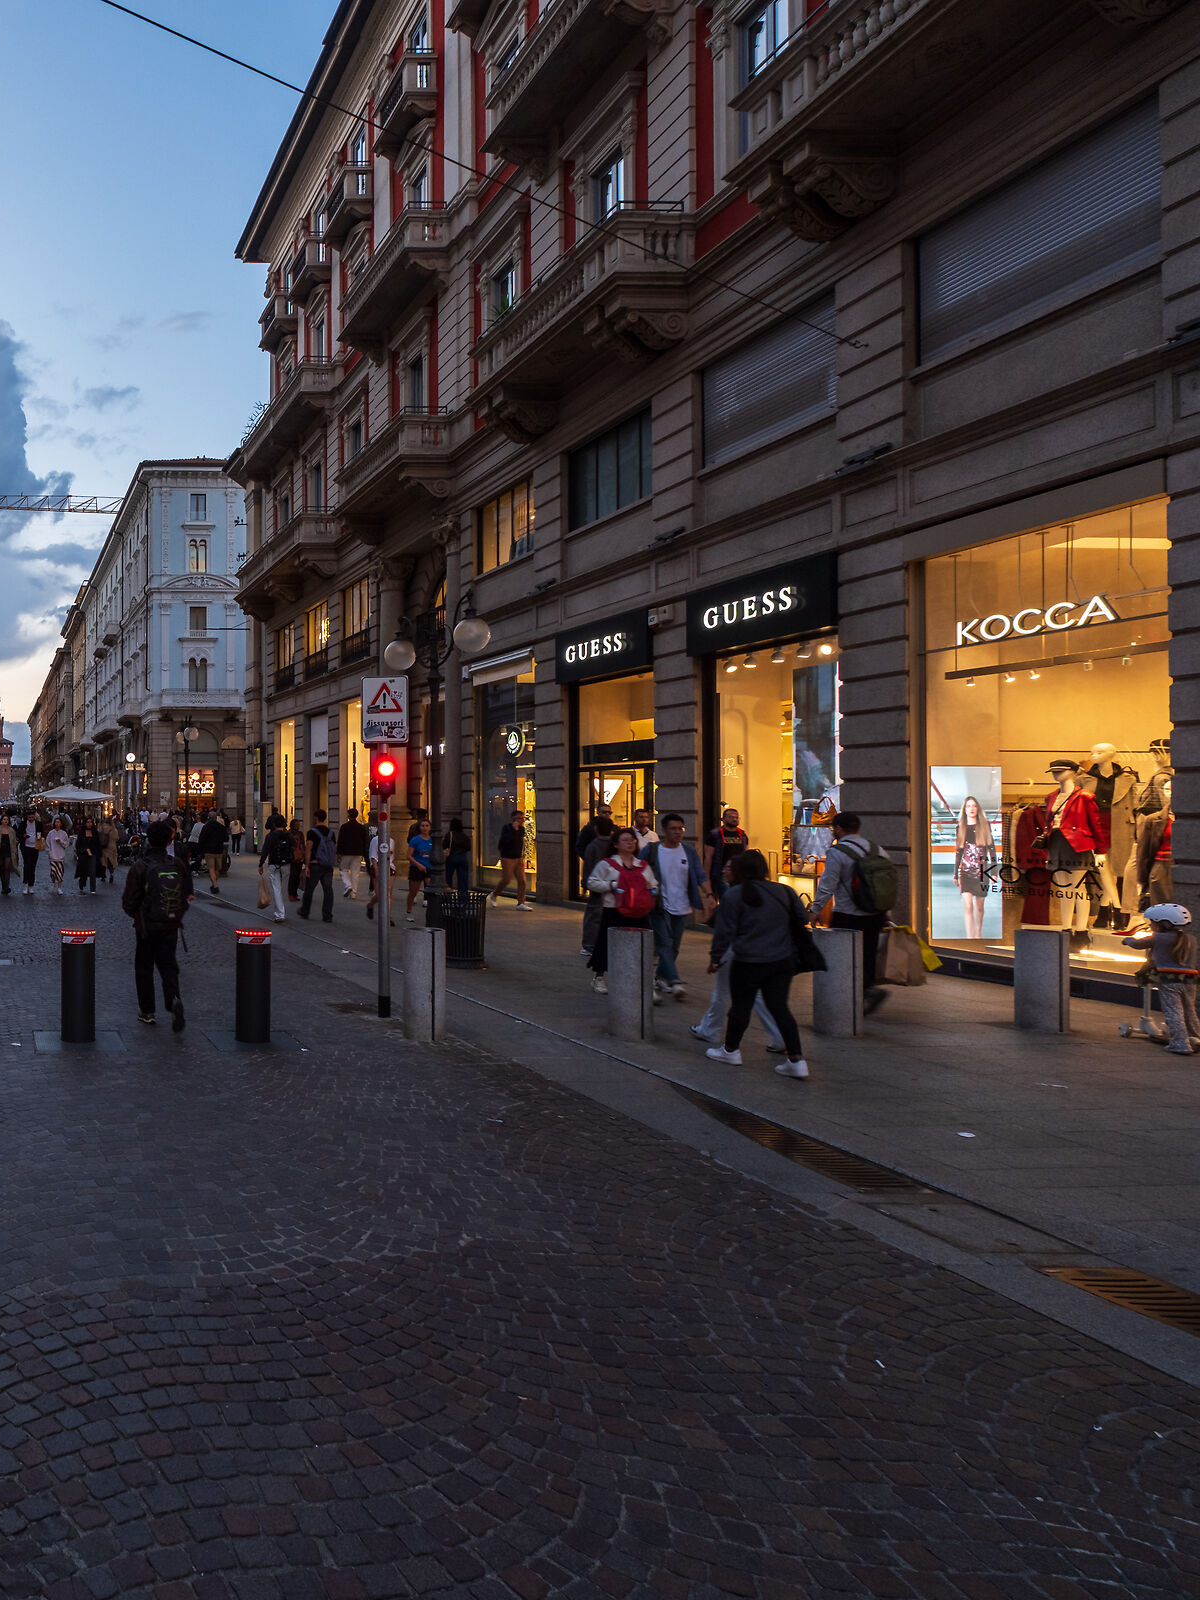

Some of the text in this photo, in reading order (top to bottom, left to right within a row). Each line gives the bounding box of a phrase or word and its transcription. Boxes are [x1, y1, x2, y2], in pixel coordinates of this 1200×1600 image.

[703, 586, 792, 629] GUESS
[956, 595, 1116, 646] KOCCA
[565, 632, 624, 663] GUESS
[980, 863, 1103, 890] KOCCA
[980, 884, 1104, 901] WEARS BURGUNDY
